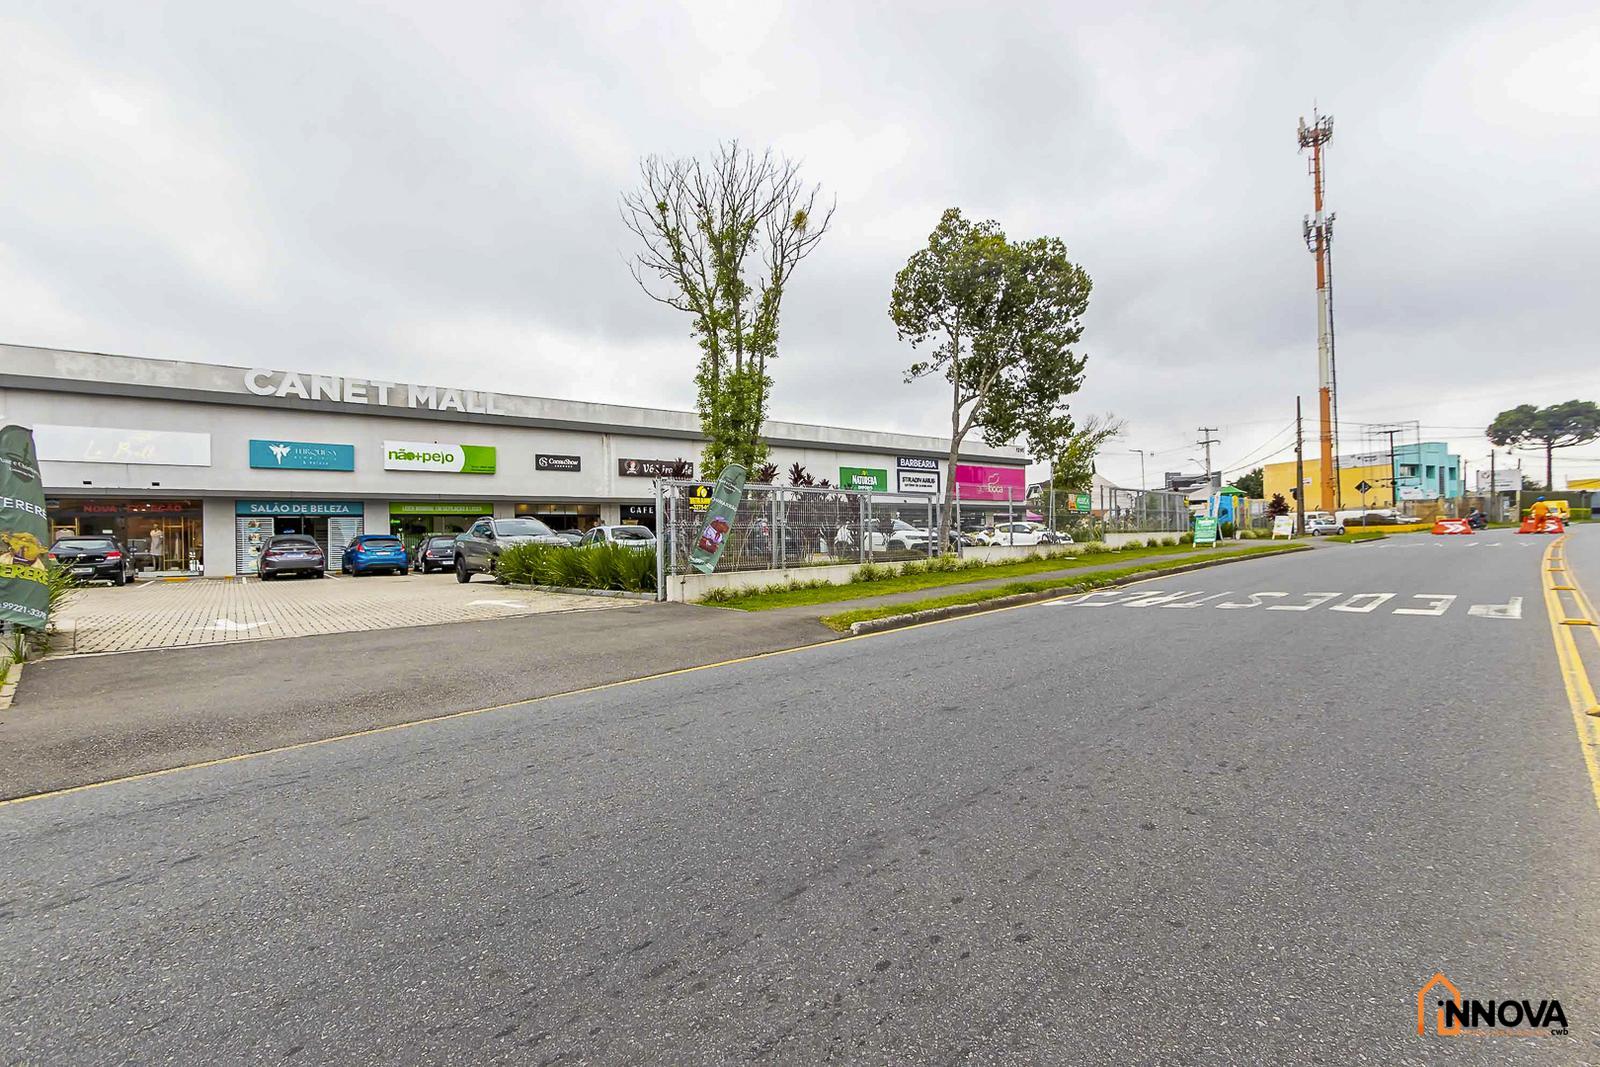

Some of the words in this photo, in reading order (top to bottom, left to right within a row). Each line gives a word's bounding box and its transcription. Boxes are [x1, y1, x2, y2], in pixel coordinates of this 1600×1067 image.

[244, 367, 394, 406] CANET
[407, 383, 507, 415] MALL
[900, 458, 937, 468] BARBEARIA
[83, 504, 118, 513] NOVA
[250, 502, 290, 513] SALÃO
[292, 504, 308, 513] DE
[310, 504, 350, 513] BELEZA
[1040, 590, 1524, 621] PEDESTRES
